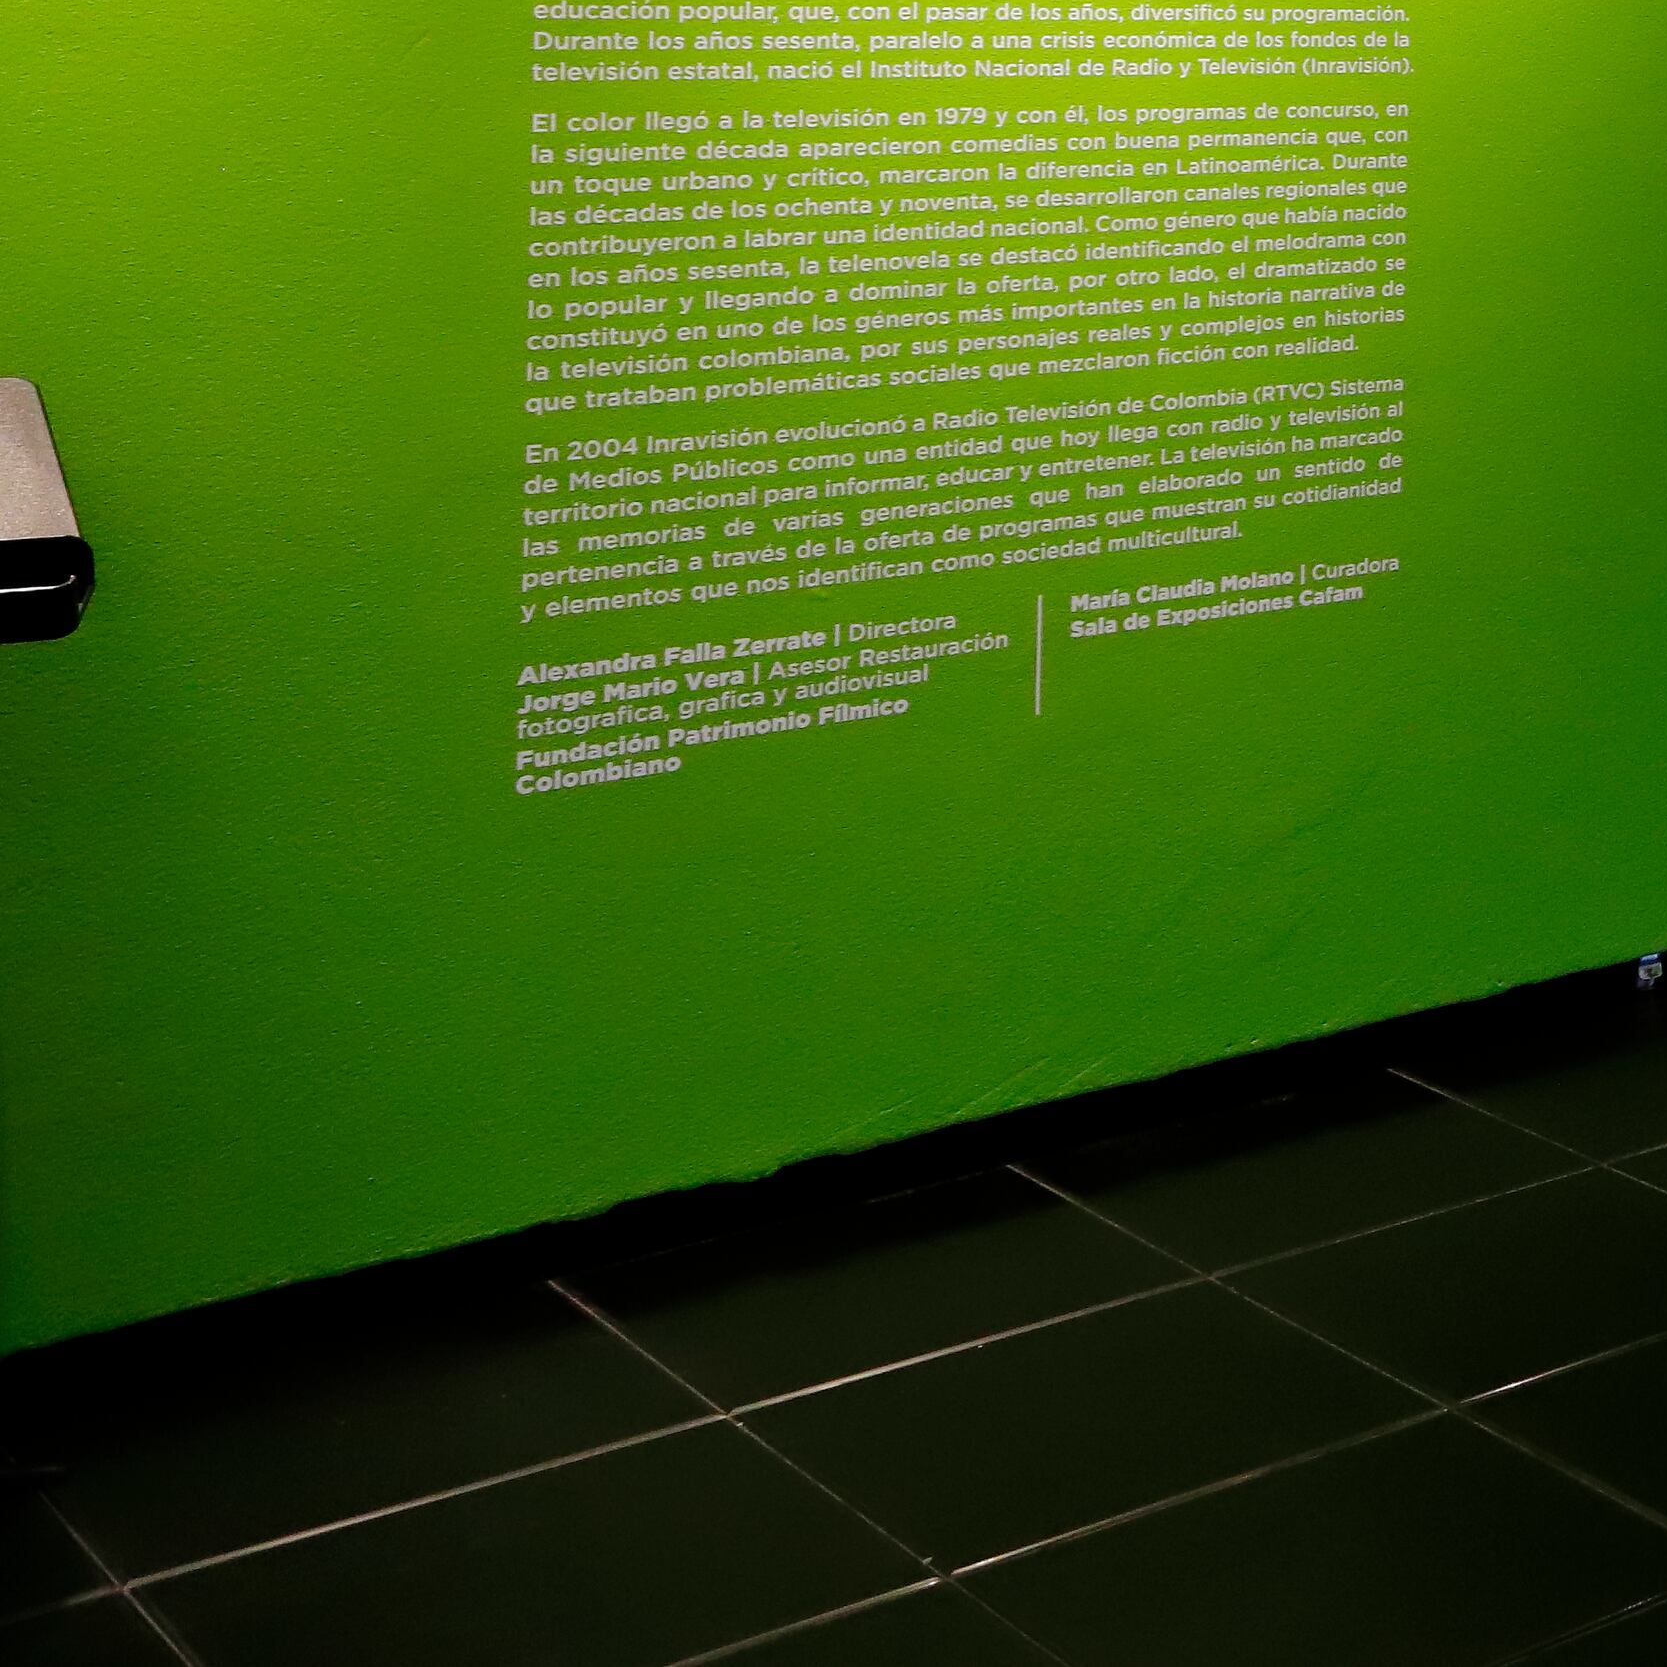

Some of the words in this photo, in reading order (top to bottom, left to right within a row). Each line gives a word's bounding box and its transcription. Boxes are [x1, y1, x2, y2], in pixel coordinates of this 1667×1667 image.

[532, 61, 659, 81] televisión
[667, 61, 759, 82] estatal,
[767, 60, 834, 79] nació
[841, 60, 862, 78] el
[870, 61, 968, 78] Instituto
[974, 59, 1071, 77] Nacional
[1077, 58, 1105, 76] de
[1112, 58, 1174, 76] Radio
[1179, 62, 1192, 78] y
[1197, 57, 1296, 75] Televisión
[1302, 57, 1414, 76] (Inravisión).
[532, 144, 554, 163] la
[565, 143, 686, 166] siguiente
[696, 140, 789, 159] década
[799, 137, 942, 160] aparecieron
[950, 134, 1058, 153] comedias
[1067, 137, 1107, 150] con
[1114, 132, 1180, 149] buena
[1188, 129, 1318, 151] permanencia
[1325, 131, 1366, 146] que,
[1374, 130, 1408, 143] con
[528, 235, 715, 257] contribuyeron
[723, 234, 737, 249] a
[744, 229, 817, 247] labrar
[823, 229, 867, 244] una
[873, 220, 985, 242] identidad
[990, 216, 1089, 237] nacional.
[1095, 215, 1158, 232] Como
[1163, 212, 1237, 233] género
[1241, 212, 1280, 229] que
[1284, 206, 1338, 224] había
[1343, 203, 1407, 221] nacido
[525, 395, 576, 415] que
[585, 385, 696, 408] trataban
[705, 371, 882, 403] problemáticas
[889, 363, 981, 386] sociales
[988, 362, 1031, 381] que
[1038, 352, 1151, 374] mezclaron
[1156, 344, 1225, 365] ficción
[1232, 344, 1269, 359] con
[1275, 334, 1359, 356] realidad.
[526, 444, 559, 464] En
[567, 437, 638, 461] 2004
[647, 427, 768, 454] Inravisión
[775, 414, 907, 443] evolucionó
[912, 418, 926, 432] a
[933, 409, 999, 430] Radio
[1005, 399, 1112, 423] Televisión
[1117, 397, 1144, 414] de
[1149, 389, 1248, 411] Colombia
[1253, 382, 1324, 404] (RTVC)
[1330, 378, 1404, 396] Sistema
[521, 605, 536, 623] y
[545, 588, 681, 617] elementos
[691, 582, 738, 603] que
[747, 576, 790, 594] nos
[798, 561, 924, 588] identifican
[931, 553, 995, 572] como
[1002, 536, 1101, 564] sociedad
[1108, 521, 1242, 552] multicultural.
[1071, 589, 1131, 612] María
[1136, 579, 1215, 604] Claudia
[1220, 571, 1295, 593] Molano
[1312, 558, 1399, 580] Curadora
[1070, 617, 1117, 638] Sala
[1123, 612, 1150, 631] de
[1157, 595, 1294, 626] Exposiciones
[1299, 586, 1363, 606] Cafam
[517, 653, 656, 686] Alexandra
[664, 642, 726, 666] Falla
[733, 631, 827, 657] Zerrate
[849, 615, 956, 642] Directora
[517, 690, 596, 715] Jorge
[603, 677, 678, 702] Mario
[684, 670, 745, 691] Vera
[768, 656, 851, 680] Asesor
[859, 632, 1008, 667] Restauración
[516, 733, 660, 770] Fundación
[668, 711, 811, 747] Patrimonio
[819, 699, 909, 725] Fílmico
[517, 705, 669, 739] fotografica,
[679, 690, 765, 720] grafica
[773, 688, 787, 706] y
[795, 664, 929, 699] audiovisual
[515, 756, 682, 795] Colombiano
